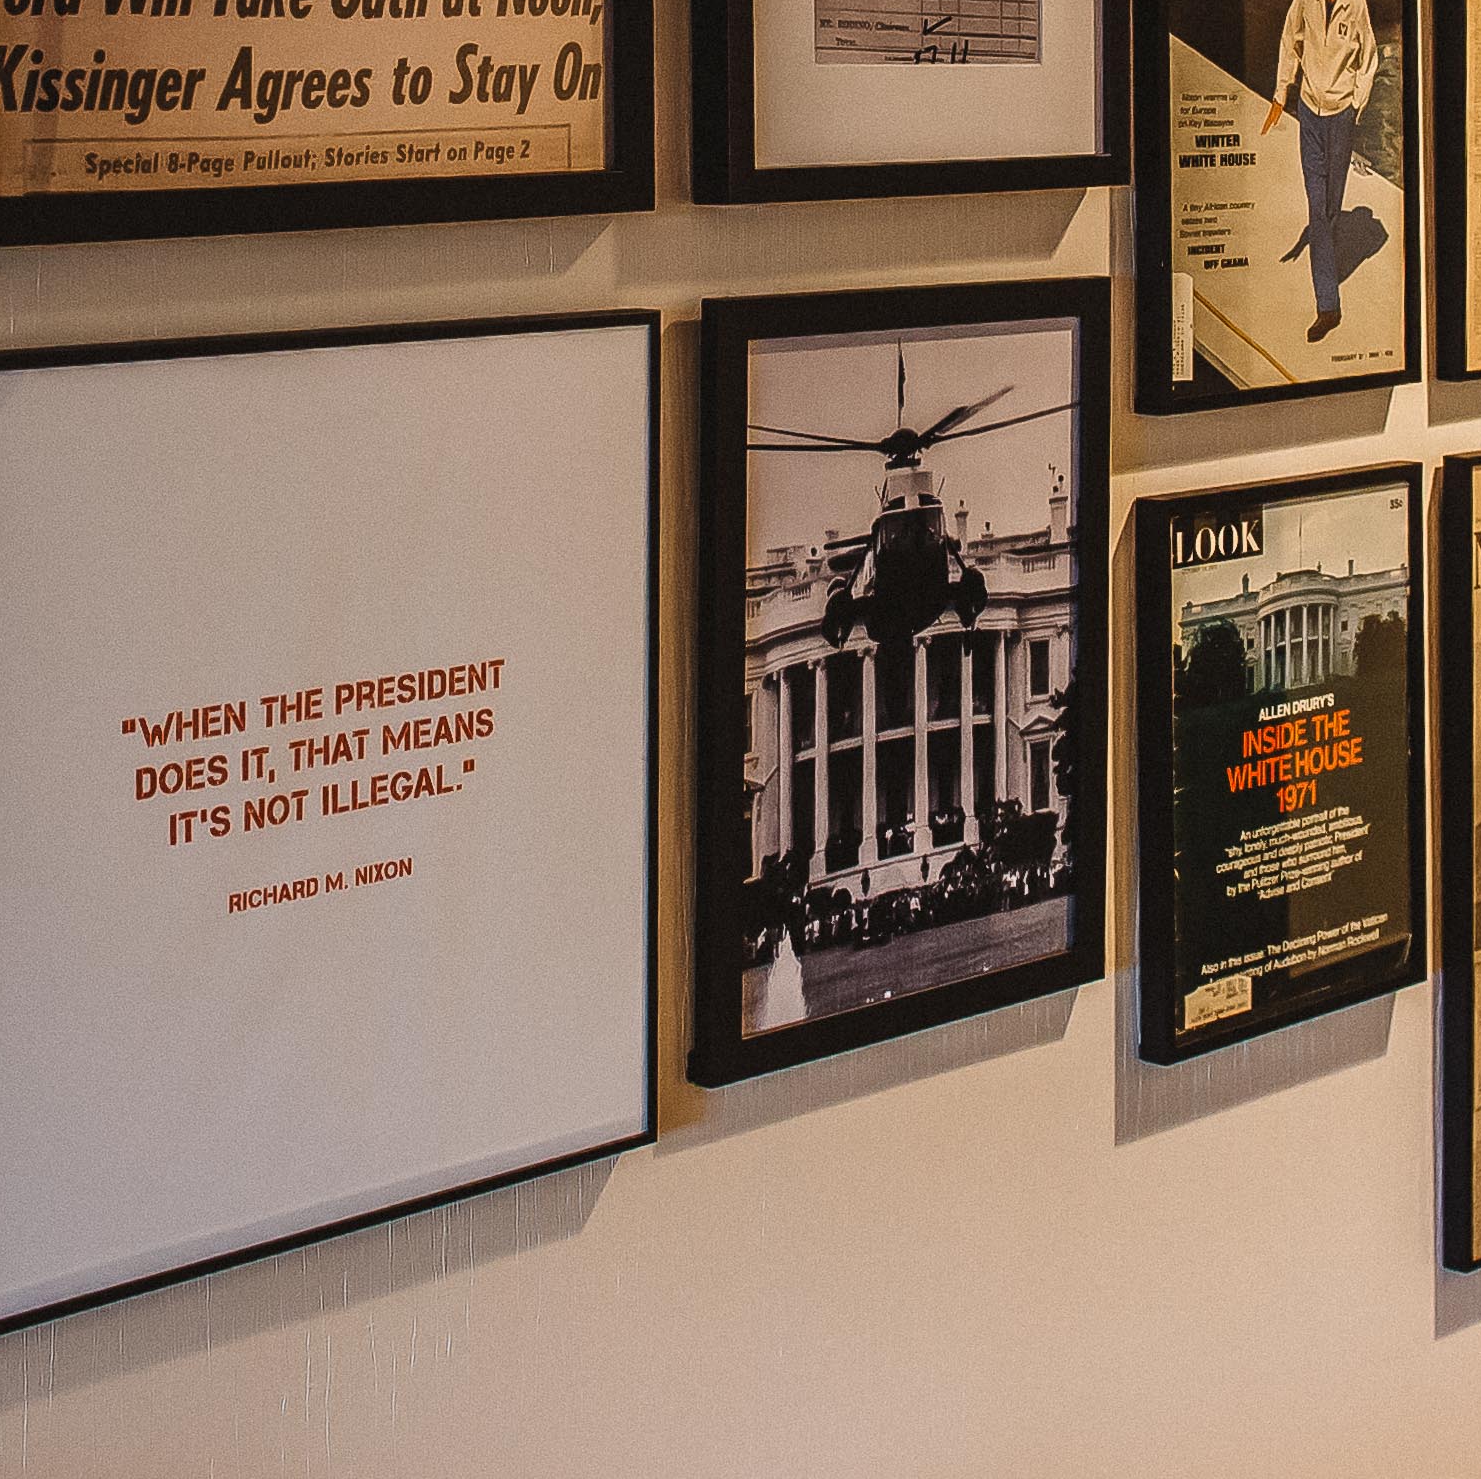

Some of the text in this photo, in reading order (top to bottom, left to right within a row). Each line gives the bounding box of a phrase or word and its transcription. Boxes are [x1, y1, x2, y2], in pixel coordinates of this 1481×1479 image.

[216, 46, 372, 125] Agrees
[392, 56, 434, 106] to
[450, 43, 540, 115] Stay
[554, 43, 602, 102] On
[85, 141, 529, 180] Special 8-Page Pullout; Stories Start on Page 2
[1179, 153, 1256, 168] WHITE HOUSE
[1195, 134, 1240, 147] WINTER
[1177, 520, 1260, 563] LOOK
[122, 659, 505, 747] "WHEN THE PRESIDENT
[1259, 693, 1334, 722] ALLEN DRURY'S
[135, 708, 494, 800] DOES IT, THAT MEANS
[1243, 709, 1351, 758] INSIDE THE
[1226, 737, 1363, 793] WHITE HOUSE
[169, 758, 476, 846] IT'S NOT ILLEGAL."
[1276, 779, 1317, 813] 1971
[229, 858, 412, 913] RICHARD M. NIXON
